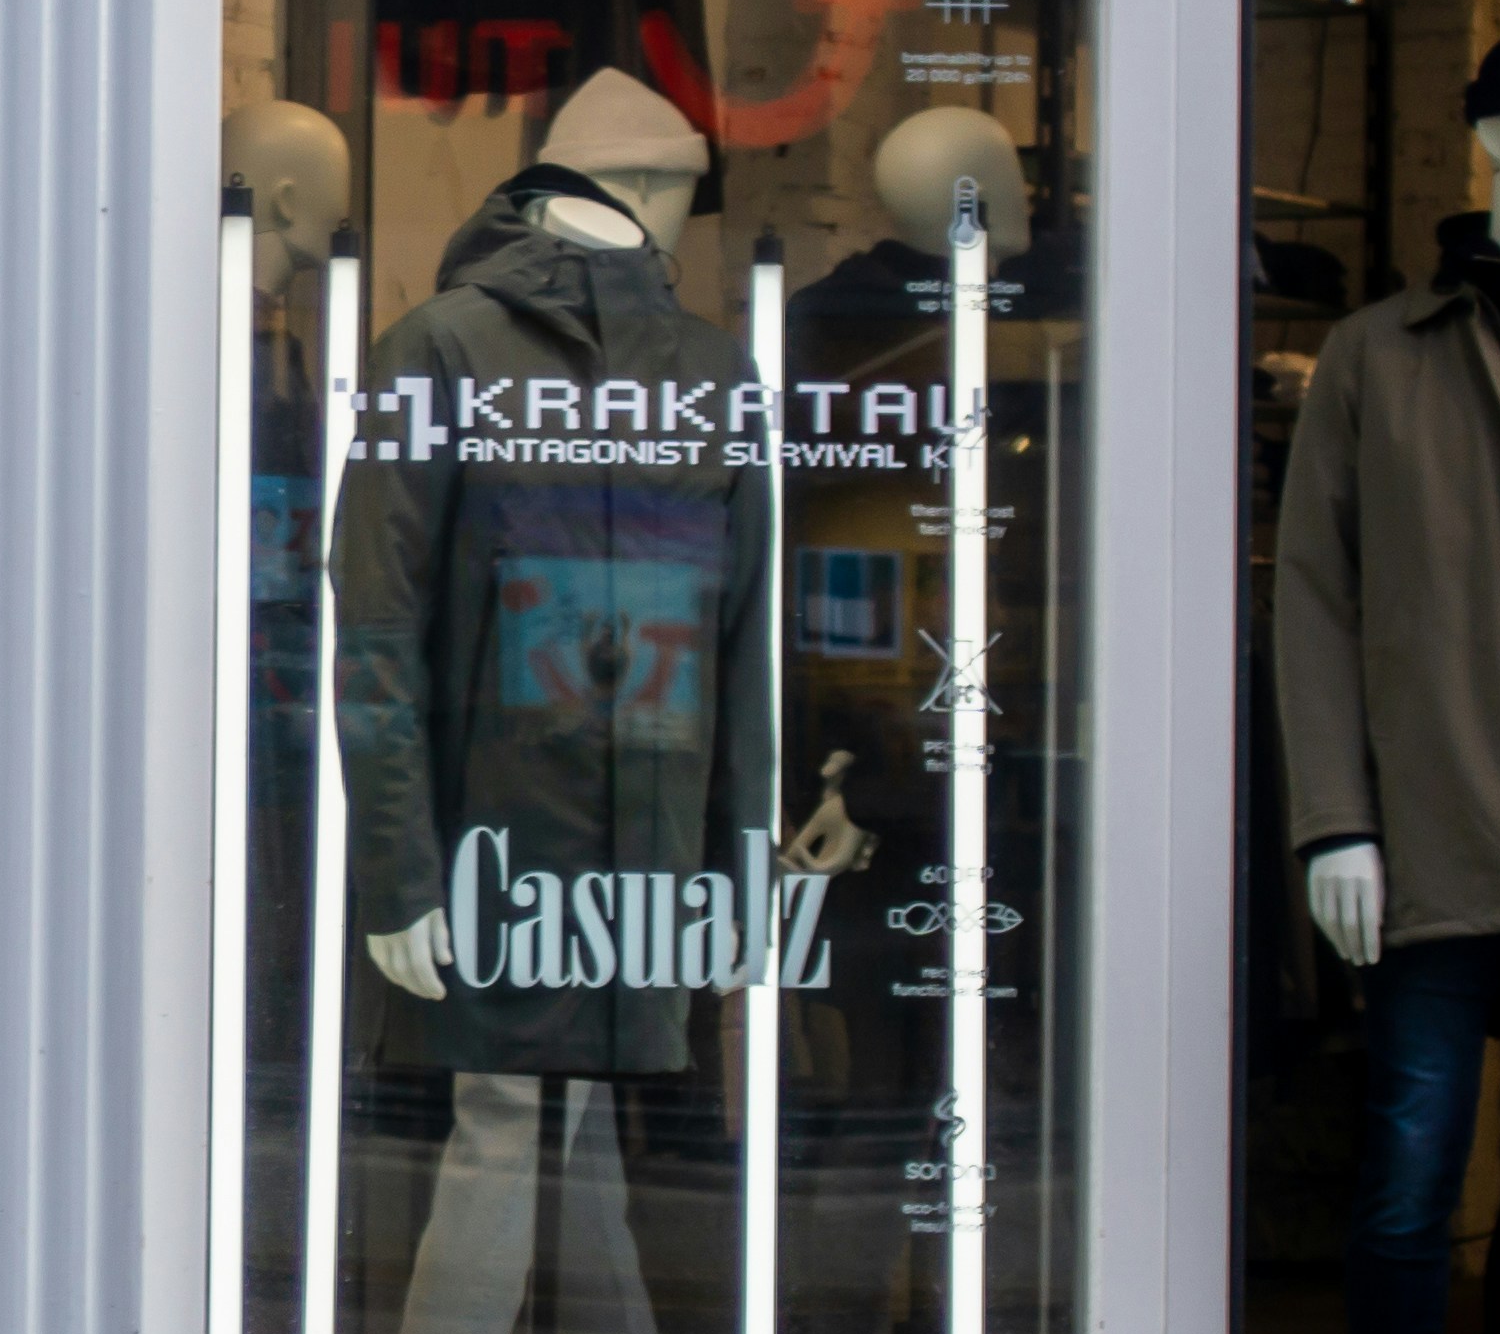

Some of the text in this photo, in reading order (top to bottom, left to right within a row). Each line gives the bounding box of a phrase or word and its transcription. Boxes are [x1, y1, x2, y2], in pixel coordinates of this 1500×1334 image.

[458, 376, 986, 436] KRAKATAU
[458, 437, 707, 465] ANTAGONIST
[722, 441, 907, 468] SURVIVAL
[450, 825, 832, 990] Casualz
